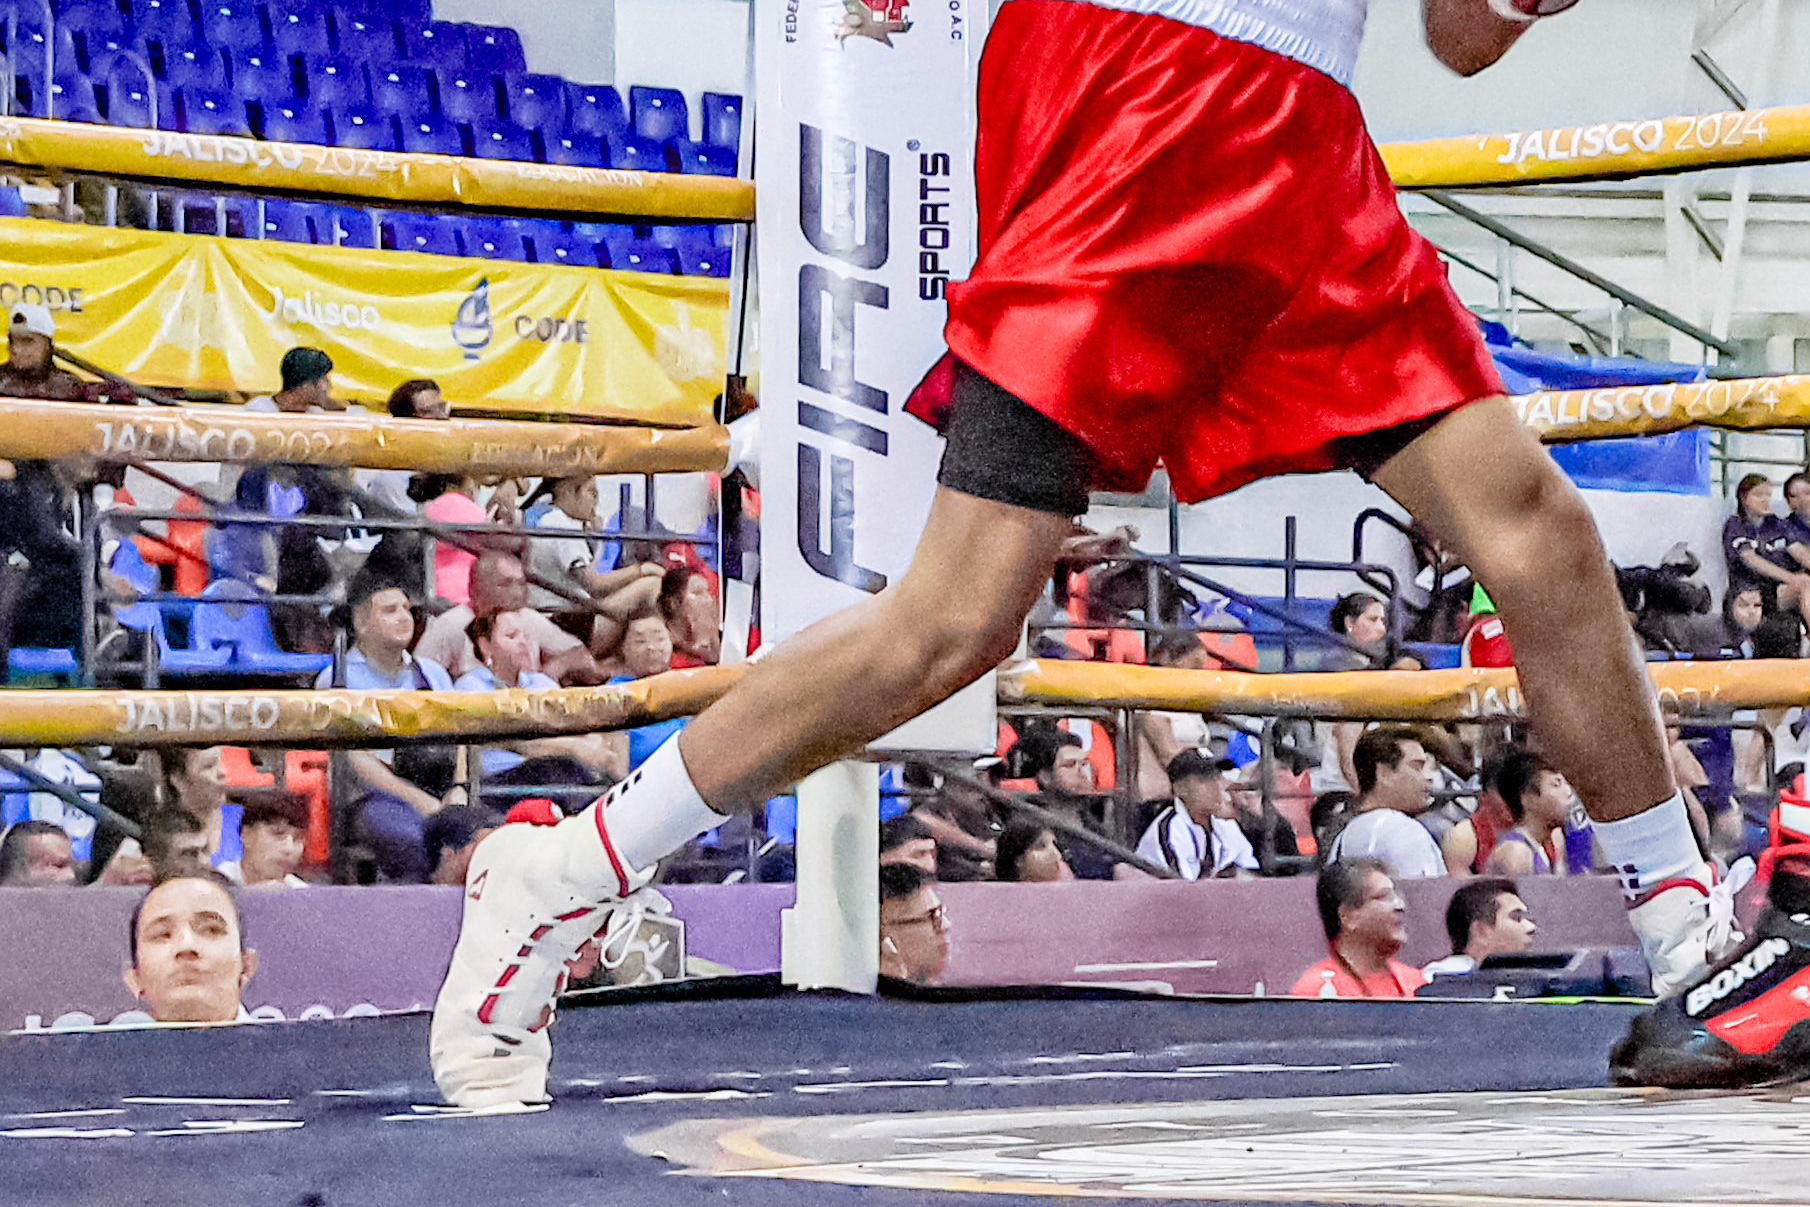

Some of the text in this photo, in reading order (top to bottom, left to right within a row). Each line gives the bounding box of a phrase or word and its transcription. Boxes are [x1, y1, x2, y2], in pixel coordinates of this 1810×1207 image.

[143, 130, 401, 178] JALISCO 2024
[1496, 110, 1769, 164] JALISCO 2024
[919, 152, 951, 301] SPORTS
[262, 286, 381, 330] Jalisco
[1511, 376, 1781, 426] JALISCO 2024
[115, 691, 279, 732] JALISCO
